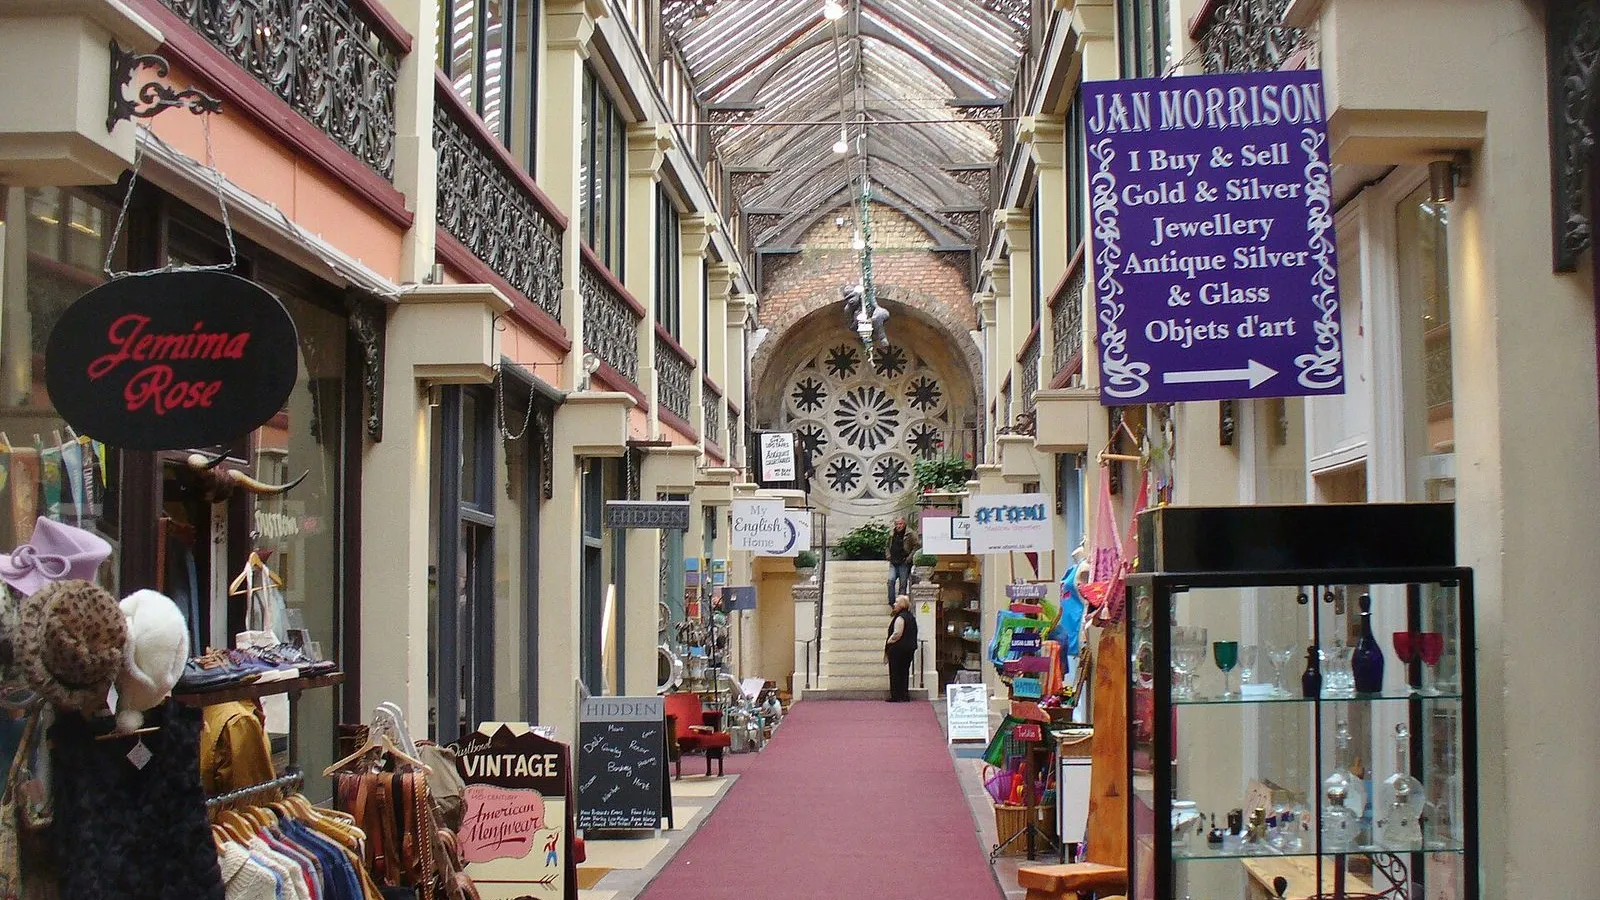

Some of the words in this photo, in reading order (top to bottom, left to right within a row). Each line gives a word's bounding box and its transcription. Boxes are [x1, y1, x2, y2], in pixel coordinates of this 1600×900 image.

[1088, 91, 1151, 135] JAN
[1159, 83, 1322, 131] MORRISON
[1128, 150, 1141, 172] I
[1149, 149, 1201, 177] Buy
[1209, 146, 1233, 168] &
[1241, 143, 1290, 167] Sell
[1121, 182, 1186, 206] Gold
[1194, 180, 1218, 203] &
[1226, 177, 1301, 202] Silver
[1150, 212, 1275, 247] Jewellery
[1122, 250, 1227, 279] Antique
[1233, 247, 1309, 270] Silver
[1167, 284, 1191, 307] &
[1199, 282, 1270, 306] Glass
[86, 313, 250, 379] Jemima
[1145, 318, 1229, 349] Objets
[1236, 315, 1297, 339] d'art
[124, 364, 223, 416] Rose
[611, 509, 685, 523] HIDDEN
[750, 505, 768, 517] My
[734, 516, 782, 536] English
[743, 537, 774, 547] Home
[586, 703, 657, 716] HIDDEN
[463, 753, 558, 777] VINTAGE
[464, 803, 535, 823] American
[468, 817, 542, 846] Menswear
